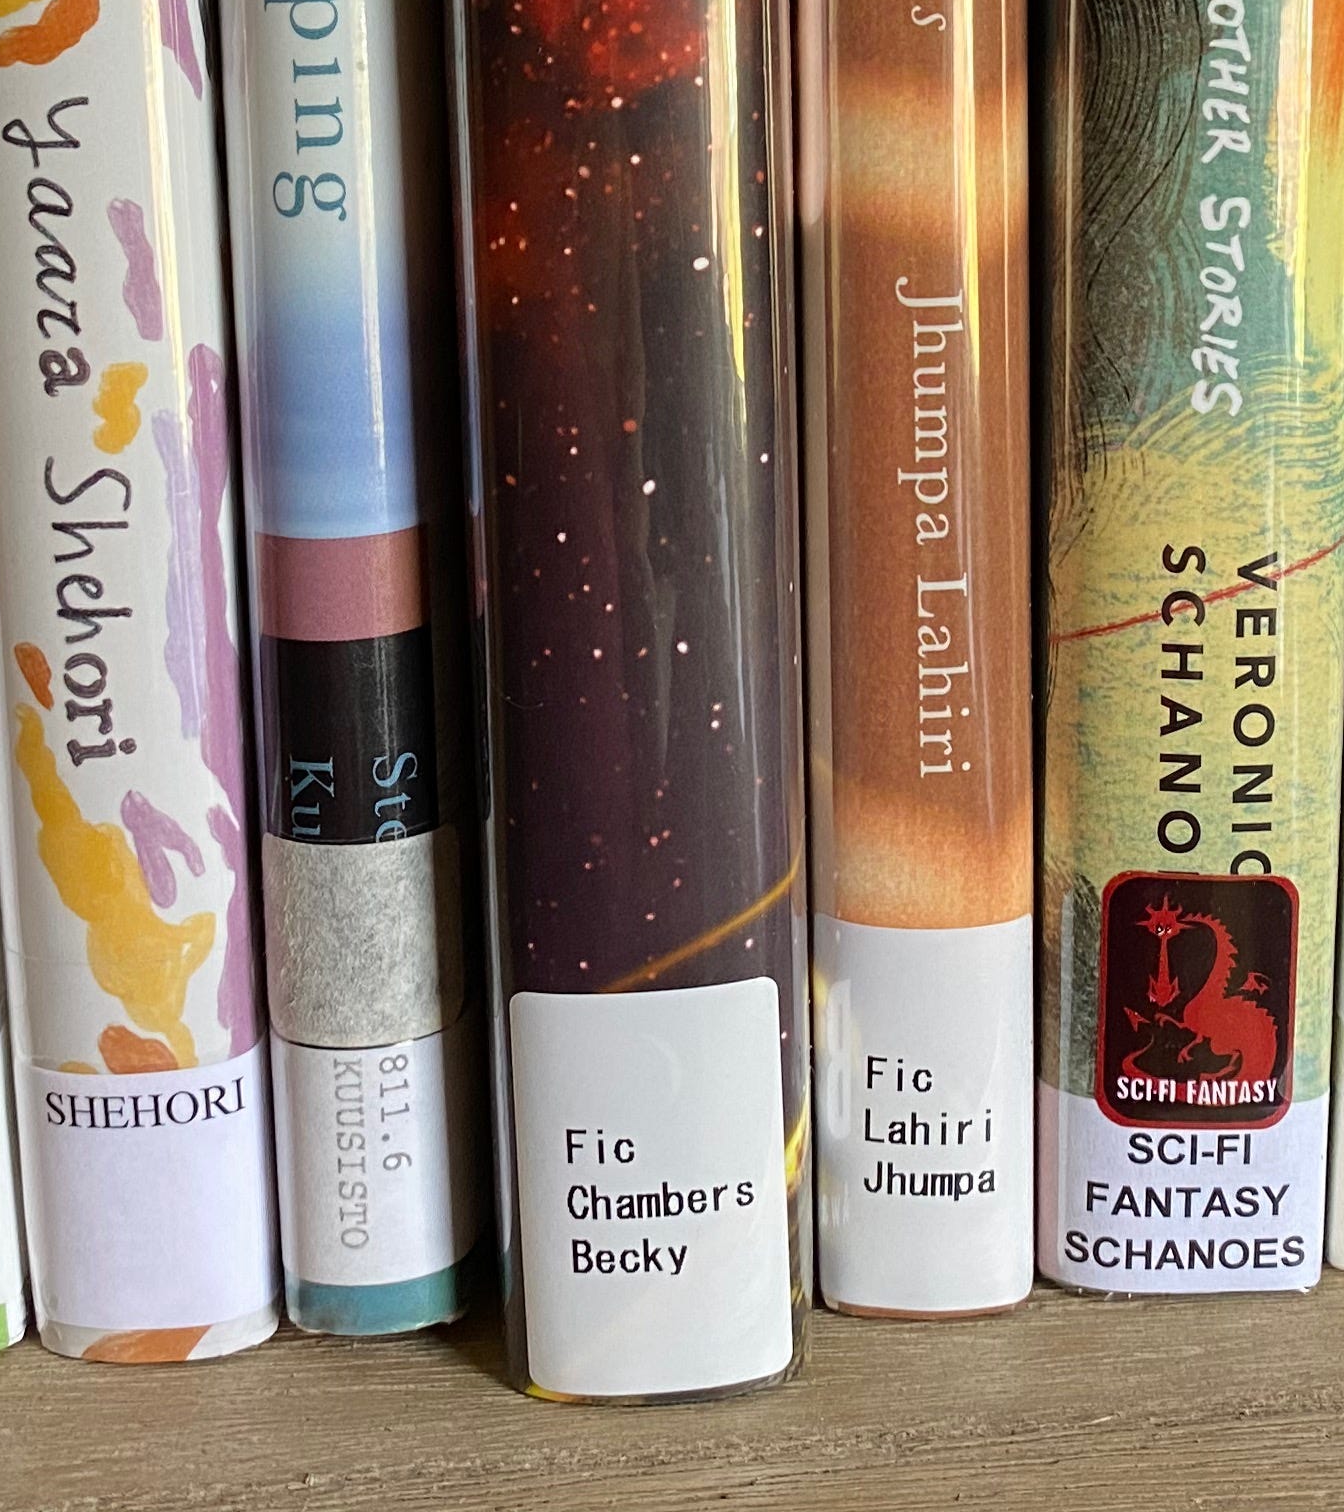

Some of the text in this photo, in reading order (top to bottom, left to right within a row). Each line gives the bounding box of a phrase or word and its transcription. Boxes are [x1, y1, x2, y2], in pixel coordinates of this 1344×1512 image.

[1191, 195, 1252, 418] STORIES
[895, 275, 971, 779] Jhumpa Lahiri
[45, 455, 137, 767] Shehori
[1157, 542, 1207, 875] SCHANO
[866, 1055, 934, 1093] Fic
[1185, 1076, 1279, 1105] FANTASY
[46, 1077, 246, 1129] SHEHORI
[378, 1053, 413, 1172] 811.6
[565, 1128, 636, 1165] Fic
[864, 1108, 993, 1145] Lahiri
[333, 1057, 370, 1251] KUUSISTO
[1126, 1133, 1253, 1168] SCI-FI
[567, 1179, 755, 1221] Chambers
[863, 1161, 996, 1202] Jhumpa
[1085, 1182, 1291, 1219] FANTASY
[571, 1239, 688, 1276] Becky
[1064, 1229, 1306, 1271] SCHANOES
